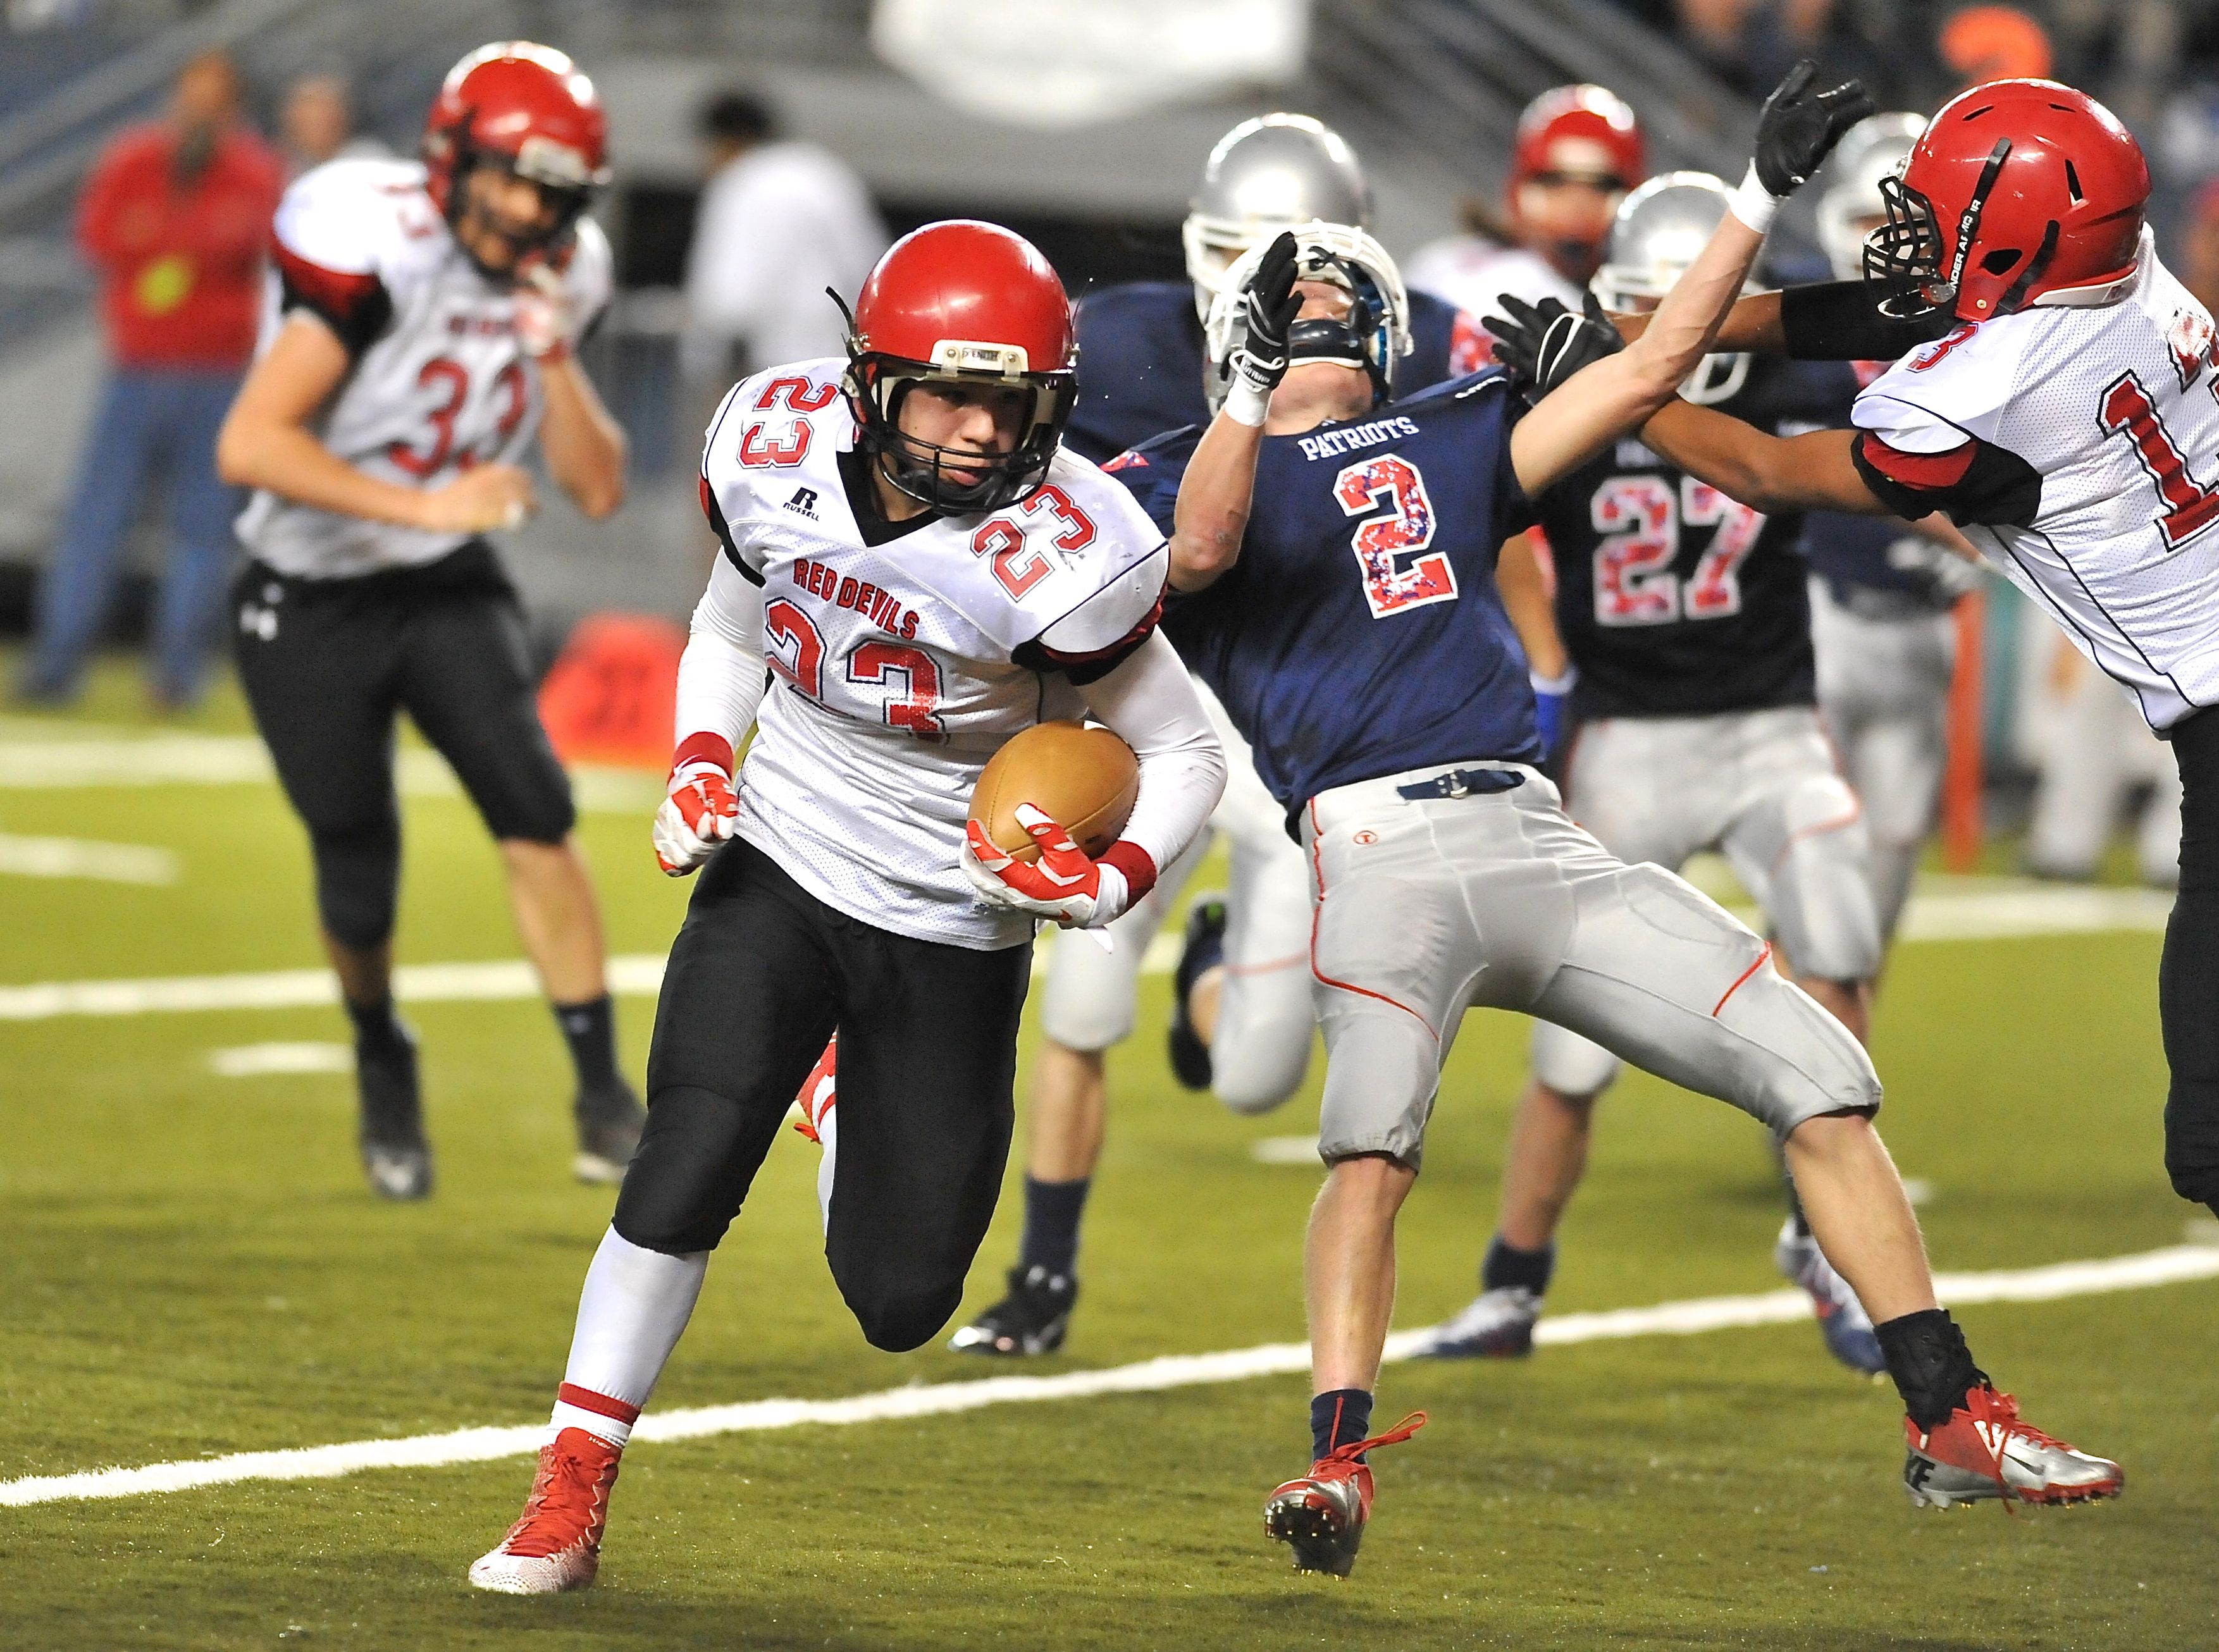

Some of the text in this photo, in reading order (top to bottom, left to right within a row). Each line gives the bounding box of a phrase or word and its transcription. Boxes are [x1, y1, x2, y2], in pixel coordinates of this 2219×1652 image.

[736, 375, 842, 470] 23
[1297, 416, 1420, 462] PATRIOTS
[2095, 368, 2219, 553] 1
[782, 502, 819, 522] RUSSELL
[970, 483, 1098, 603] 23
[1332, 452, 1459, 619] 2
[1590, 474, 1767, 626] 27
[793, 558, 920, 640] RED DEVILS
